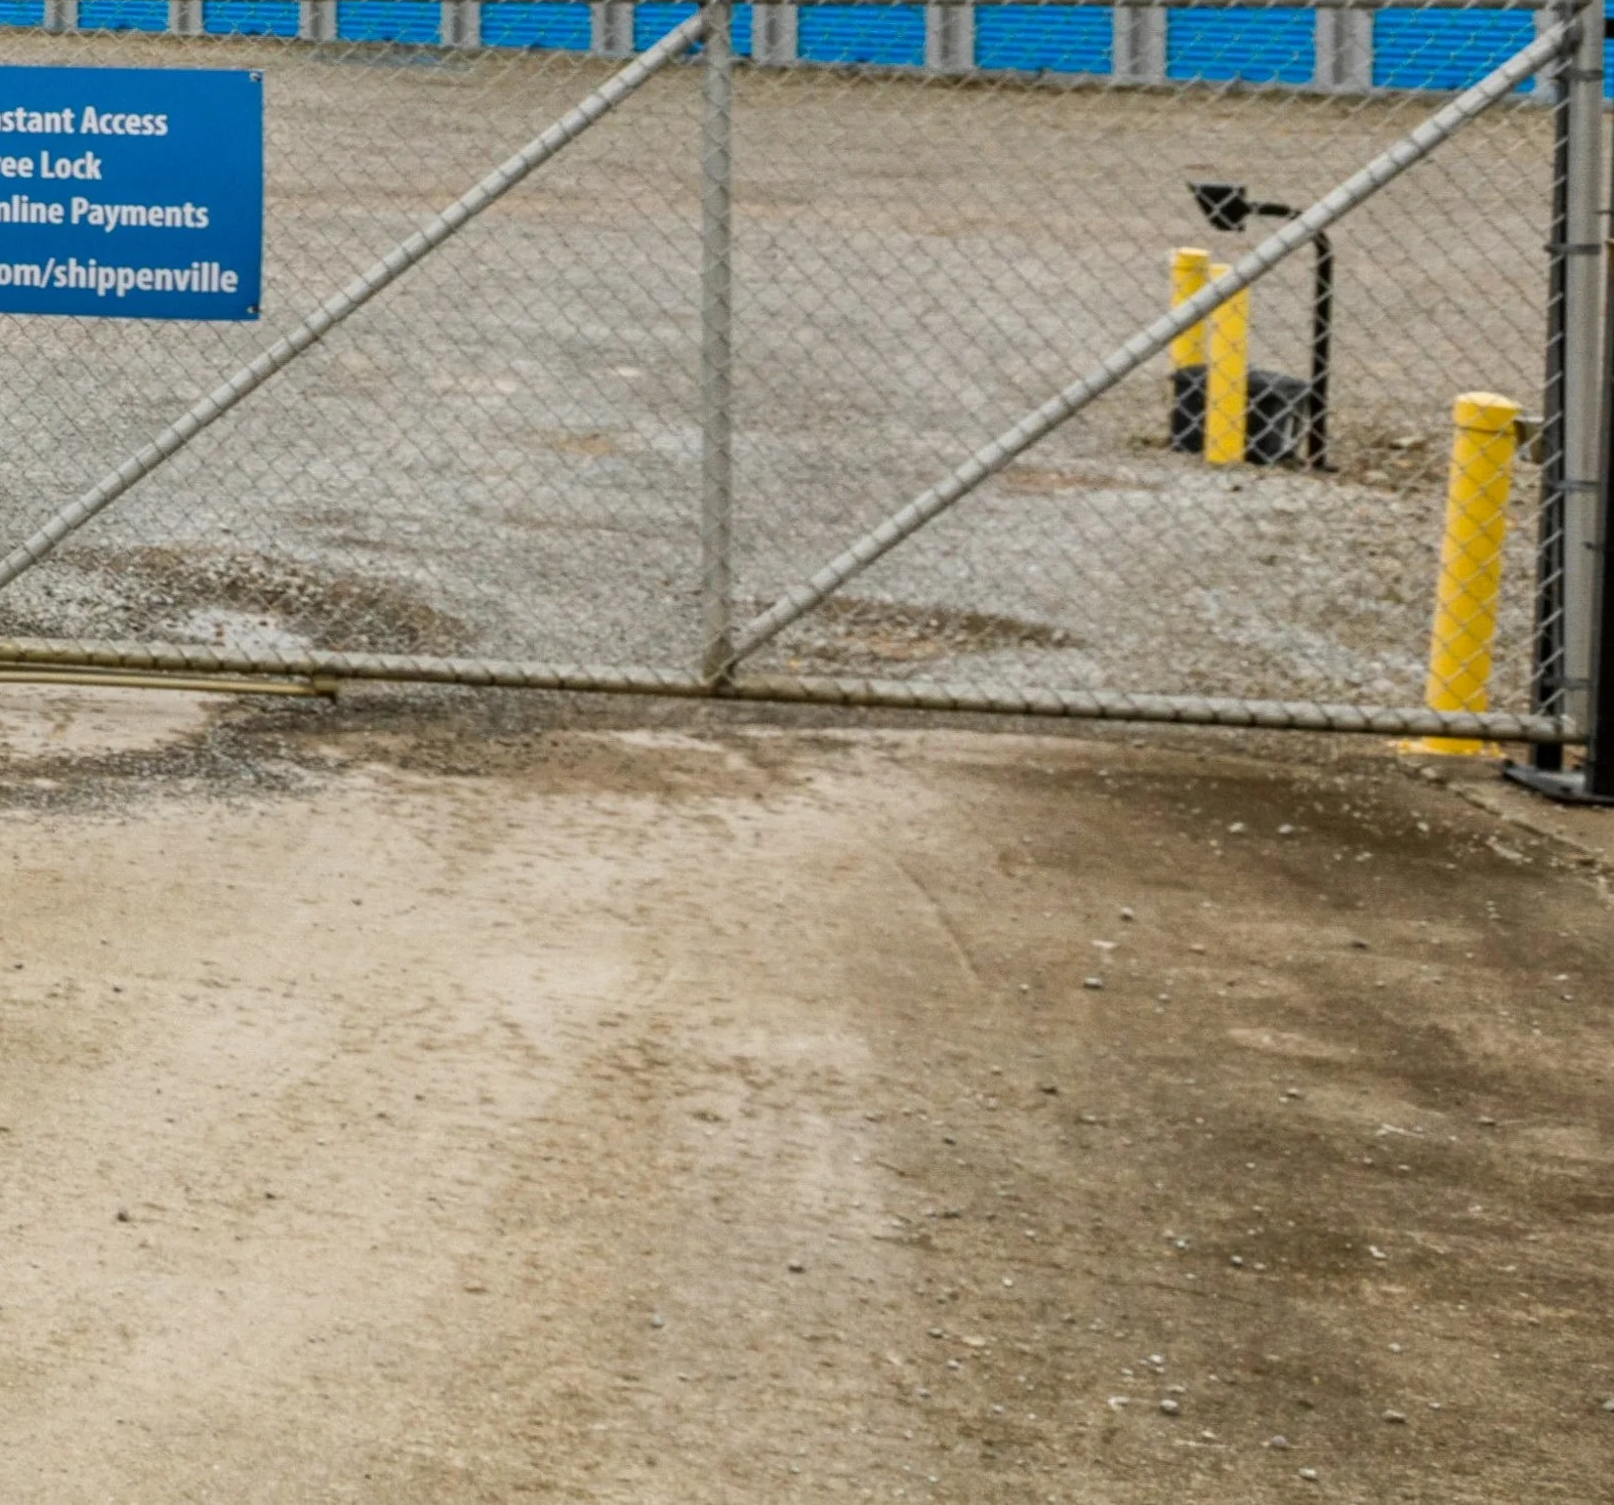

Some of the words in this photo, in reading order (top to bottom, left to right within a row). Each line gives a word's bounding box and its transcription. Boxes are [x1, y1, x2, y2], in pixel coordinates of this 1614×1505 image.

[80, 106, 168, 136] Access
[41, 151, 101, 179] Lock
[71, 196, 209, 233] Payments
